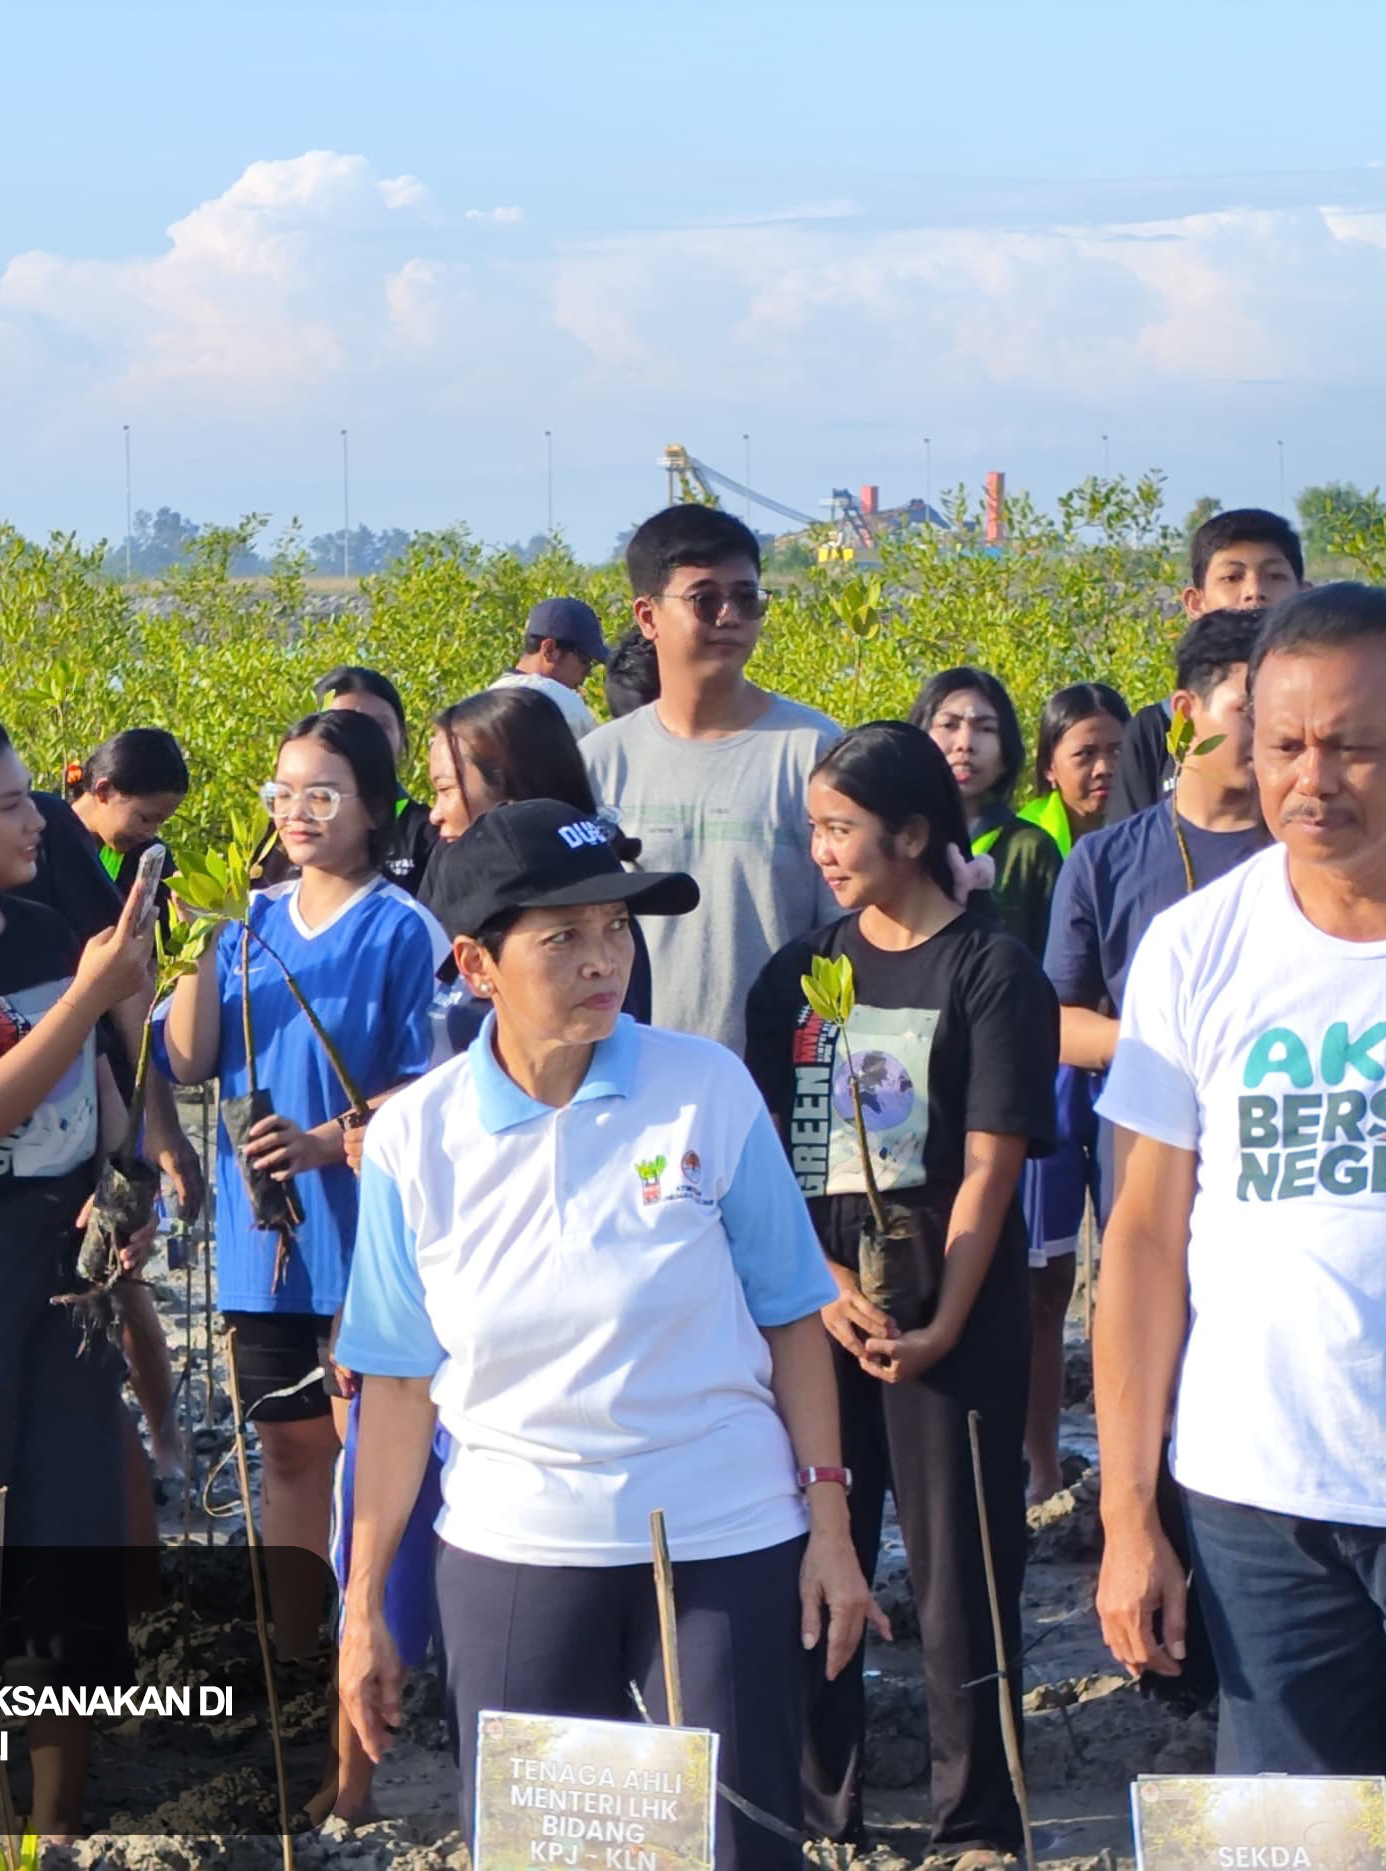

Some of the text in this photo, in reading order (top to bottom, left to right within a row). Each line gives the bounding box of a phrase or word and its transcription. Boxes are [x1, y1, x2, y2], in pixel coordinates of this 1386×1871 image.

[791, 1066, 831, 1198] GREEN
[509, 1758, 682, 1794] TENAGA AHLI
[510, 1784, 678, 1822] MENTERI LHK
[542, 1814, 645, 1844] BIDANG
[530, 1840, 577, 1865] KPJ
[605, 1847, 656, 1871] KLN
[1219, 1846, 1312, 1868] SEKDA
